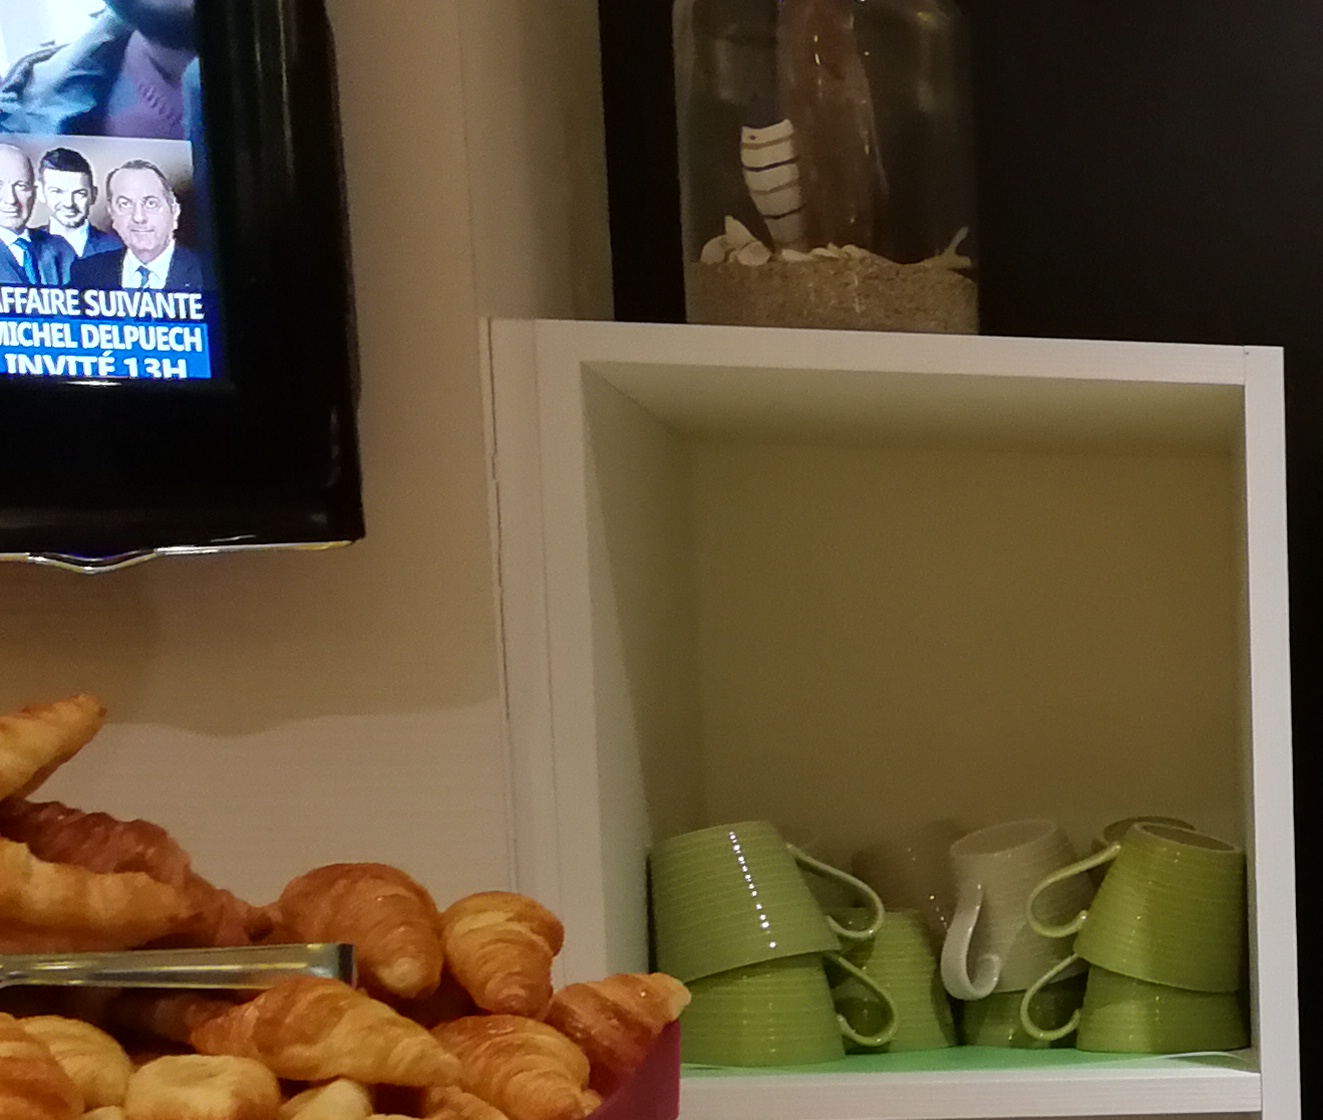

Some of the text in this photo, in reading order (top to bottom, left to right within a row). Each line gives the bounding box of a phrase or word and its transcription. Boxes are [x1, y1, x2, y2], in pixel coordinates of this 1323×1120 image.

[84, 289, 205, 320] SUIVANTE
[80, 324, 202, 352] DELPUECH
[4, 350, 188, 378] INVITÉ 13H
